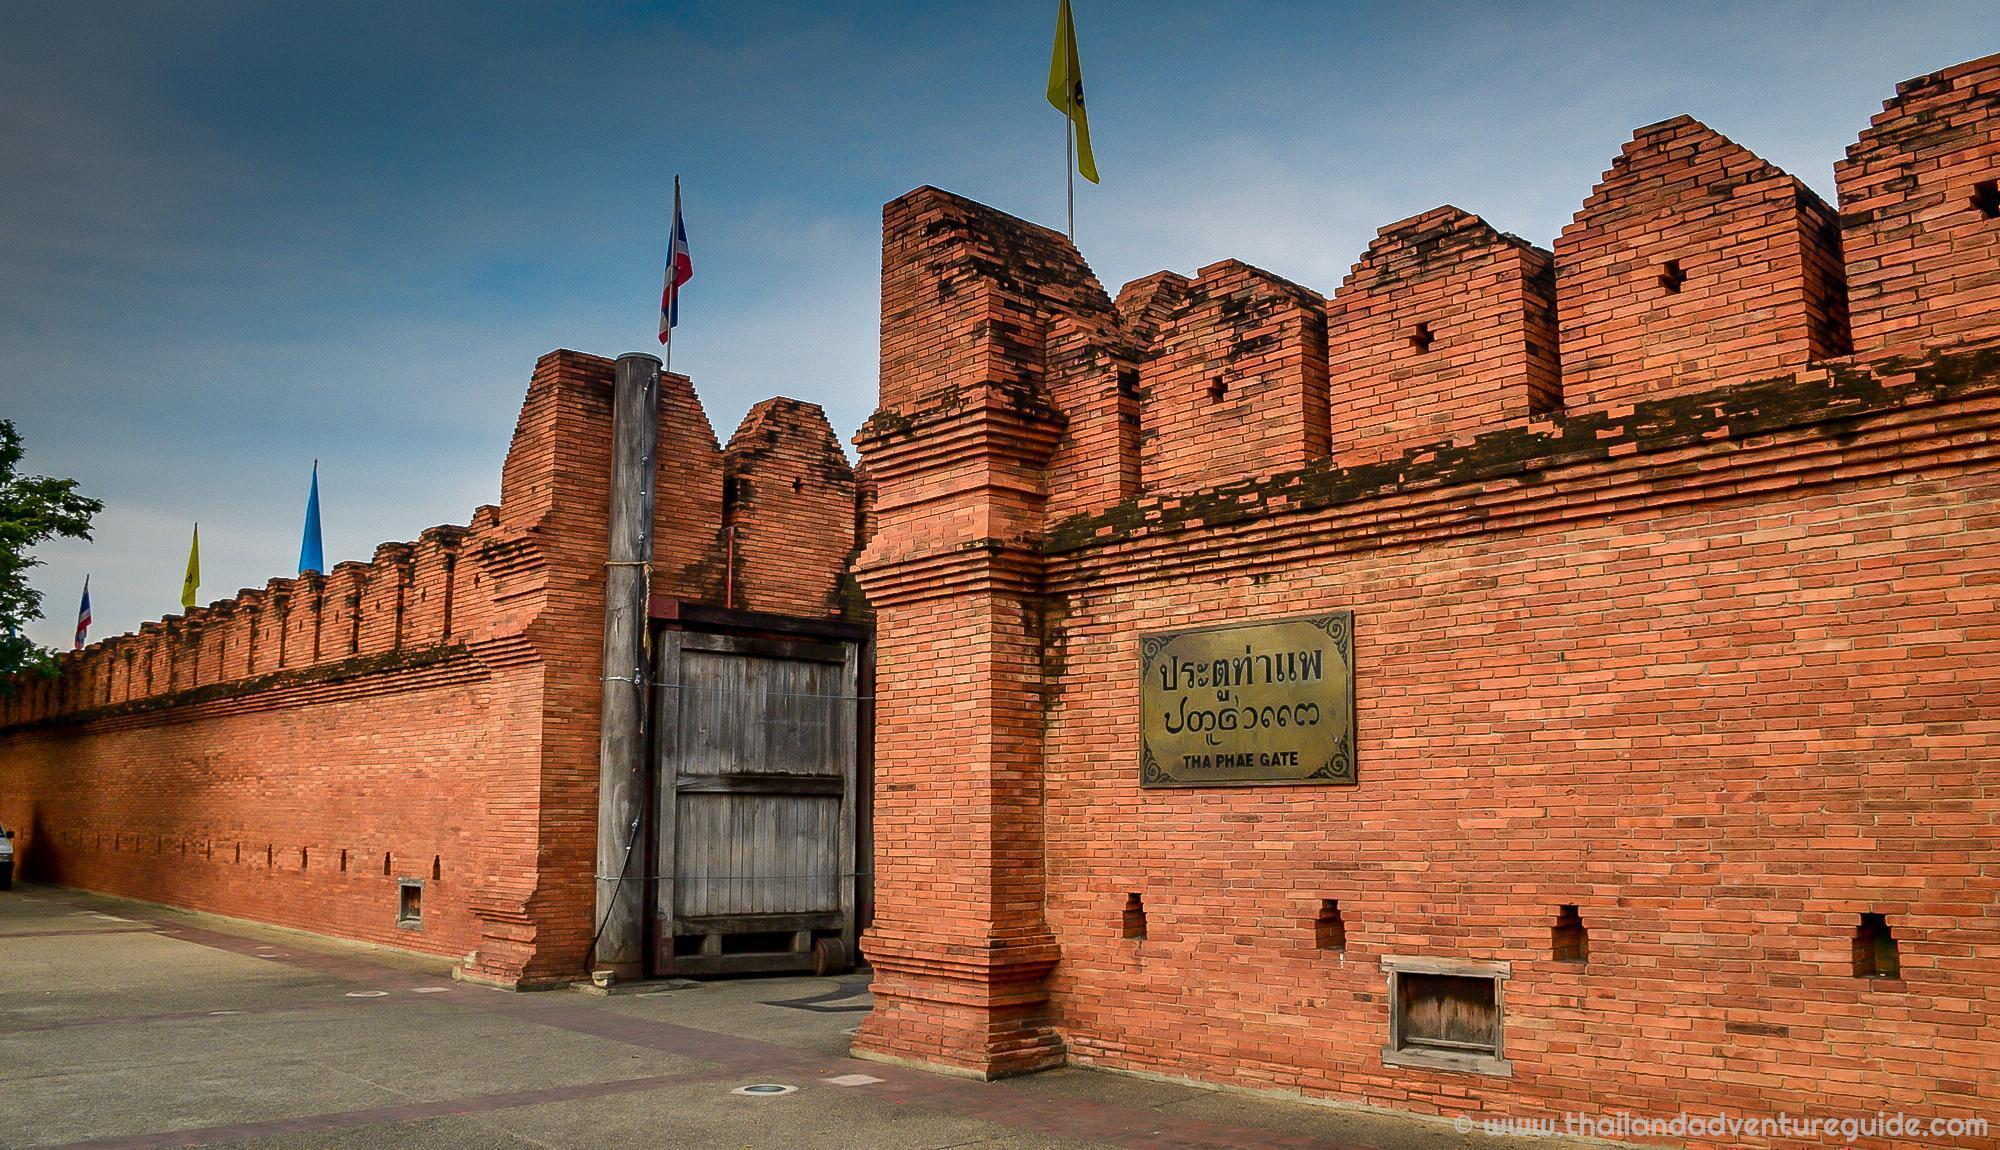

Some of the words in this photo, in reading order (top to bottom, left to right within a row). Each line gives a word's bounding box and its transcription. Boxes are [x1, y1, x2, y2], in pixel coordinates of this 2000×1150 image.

[1159, 645, 1323, 702] ประตูท่าแพ
[1183, 755, 1211, 769] THA
[1216, 753, 1254, 767] PHAE
[1260, 751, 1299, 766] GATE
